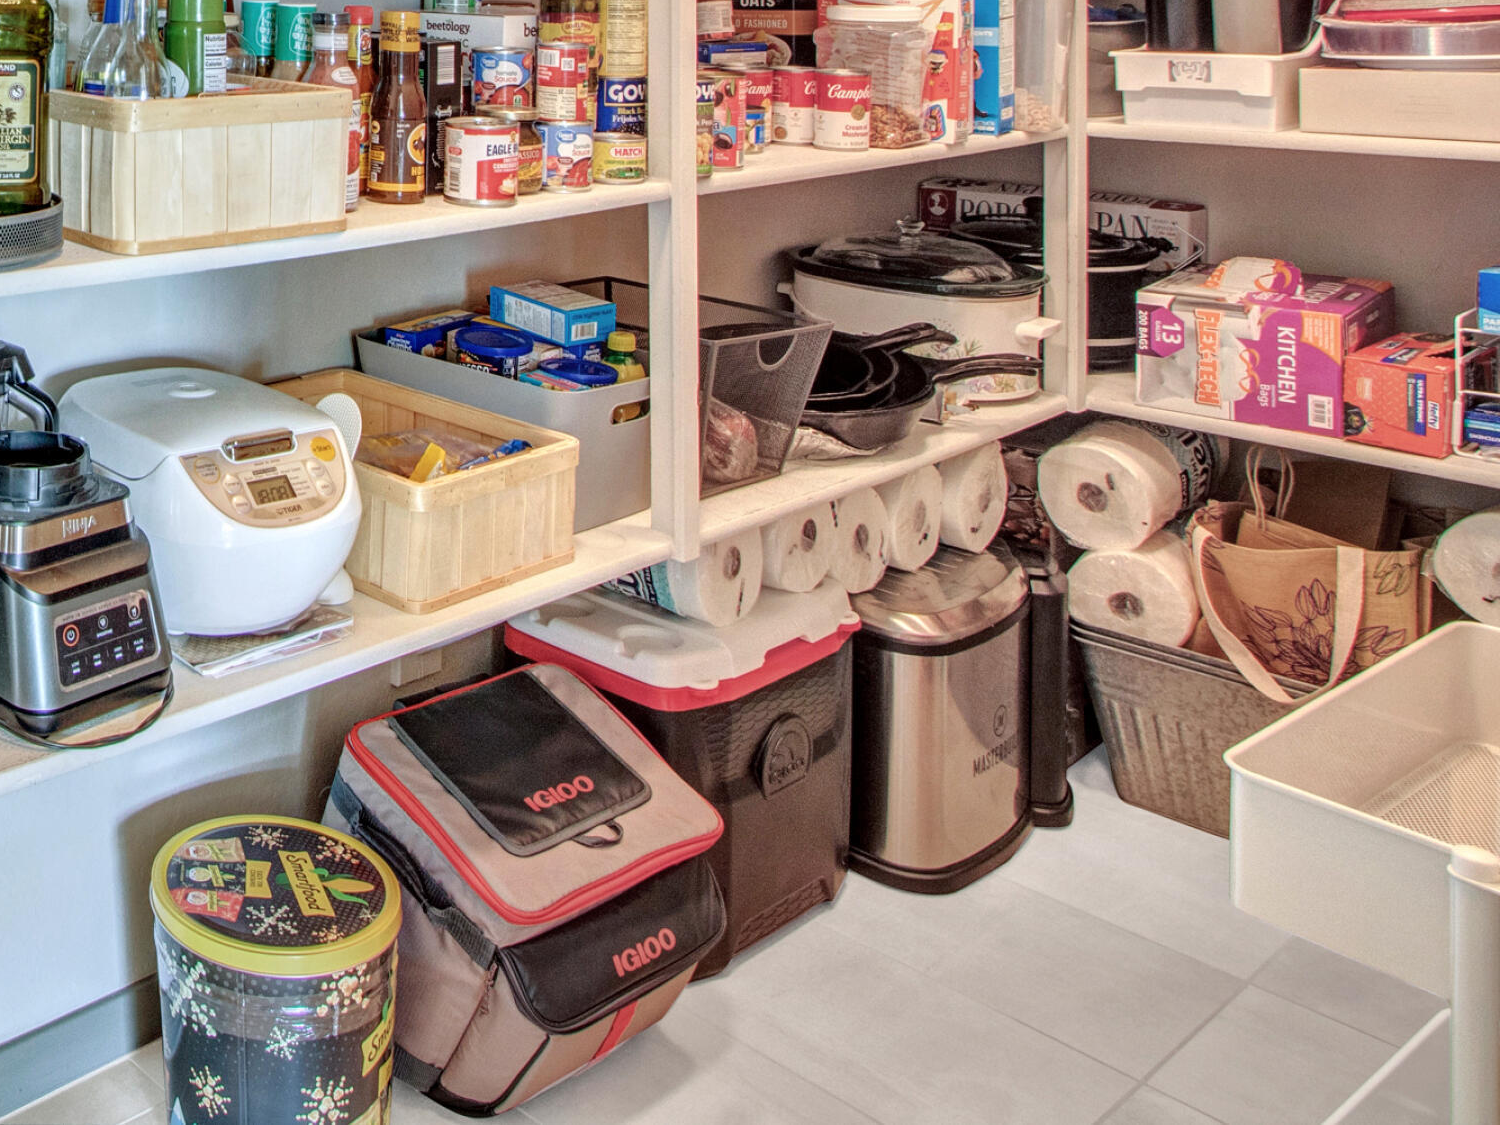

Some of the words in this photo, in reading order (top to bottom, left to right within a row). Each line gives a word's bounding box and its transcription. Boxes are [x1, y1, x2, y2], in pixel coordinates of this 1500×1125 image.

[426, 20, 471, 35] beetology
[743, 19, 788, 29] FASHIONED
[607, 84, 646, 103] GOY
[486, 144, 513, 157] EAGLE
[614, 147, 643, 157] HATCH
[1138, 309, 1149, 325] 200
[1138, 326, 1149, 350] BAGS
[1161, 322, 1182, 345] 13
[1195, 308, 1223, 407] FLEX-TECH
[1277, 325, 1296, 404] KITCHEN
[1257, 383, 1271, 407] Bags
[1428, 401, 1440, 430] Hefty
[283, 505, 303, 515] TIGER
[62, 515, 97, 539] NINJA
[524, 775, 595, 813] IGLOO
[286, 853, 328, 912] Smartfood
[612, 927, 677, 978] IGLOO
